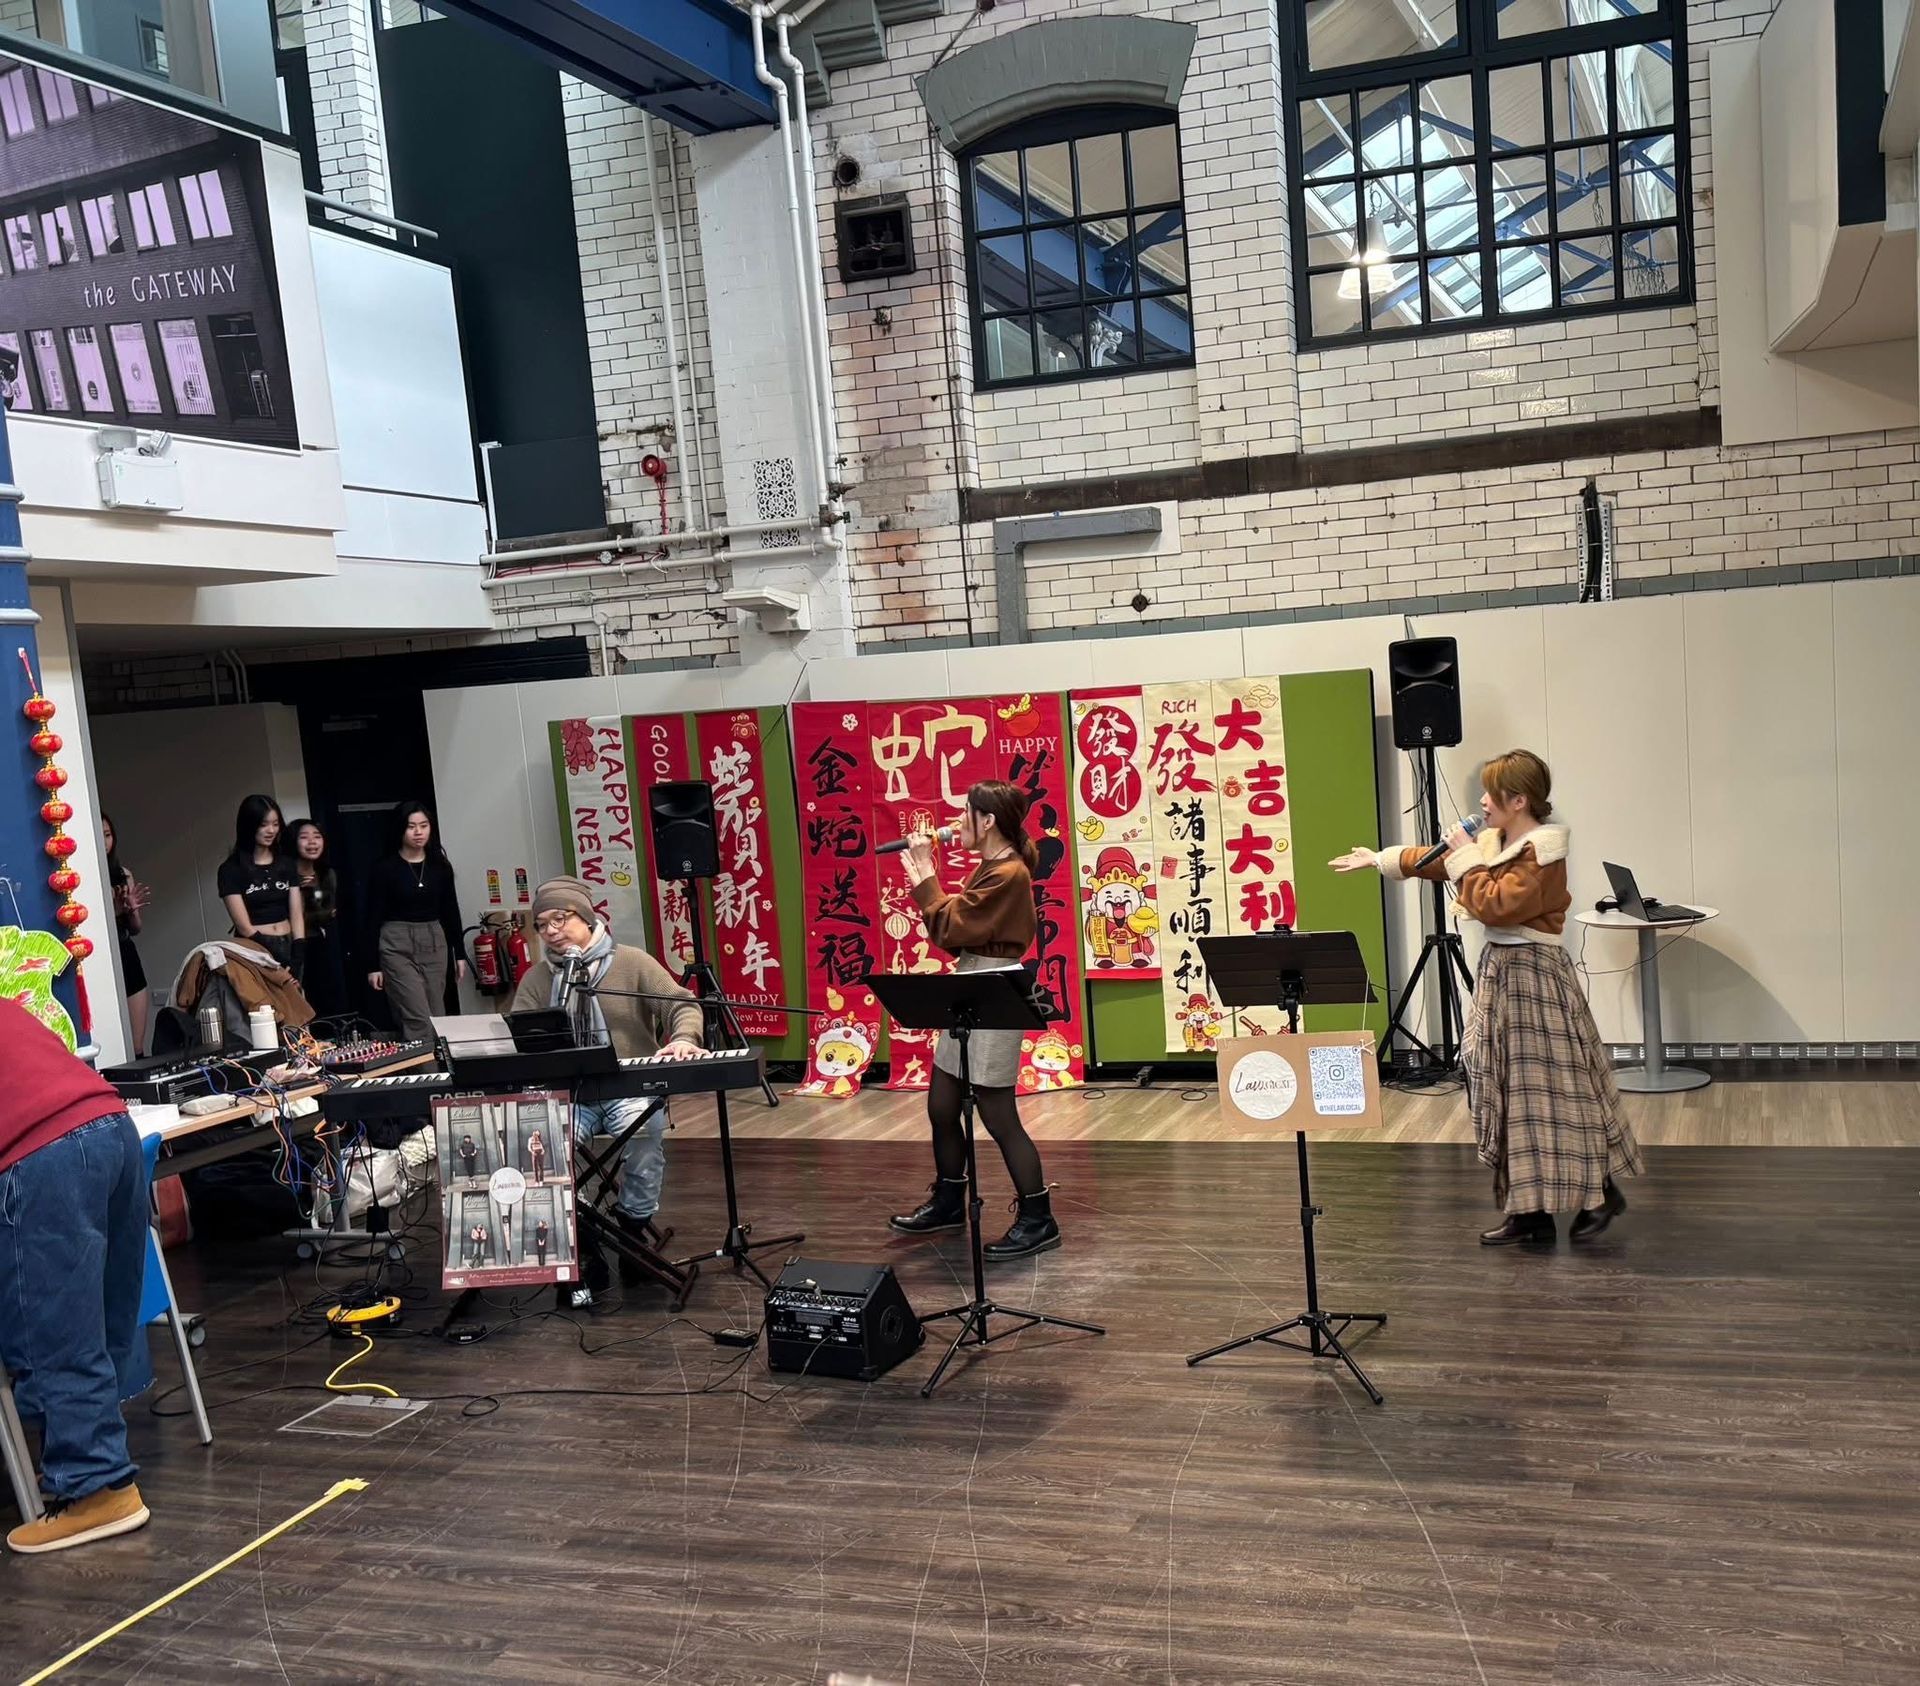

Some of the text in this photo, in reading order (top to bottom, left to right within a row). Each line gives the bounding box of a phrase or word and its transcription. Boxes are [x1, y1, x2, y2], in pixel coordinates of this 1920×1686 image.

[83, 264, 236, 309] the GATEWAY
[999, 736, 1058, 754] HAPPY
[1161, 699, 1196, 715] RICH
[598, 727, 633, 851] HAPPY
[872, 704, 987, 808] 蛇
[1087, 710, 1131, 811] 發財
[575, 807, 606, 885] NEW
[1214, 698, 1296, 932] 大吉大利
[807, 735, 875, 986] 金蛇送福
[663, 879, 694, 962] 新年
[726, 993, 779, 1008] HAPPY
[756, 1011, 779, 1022] Year
